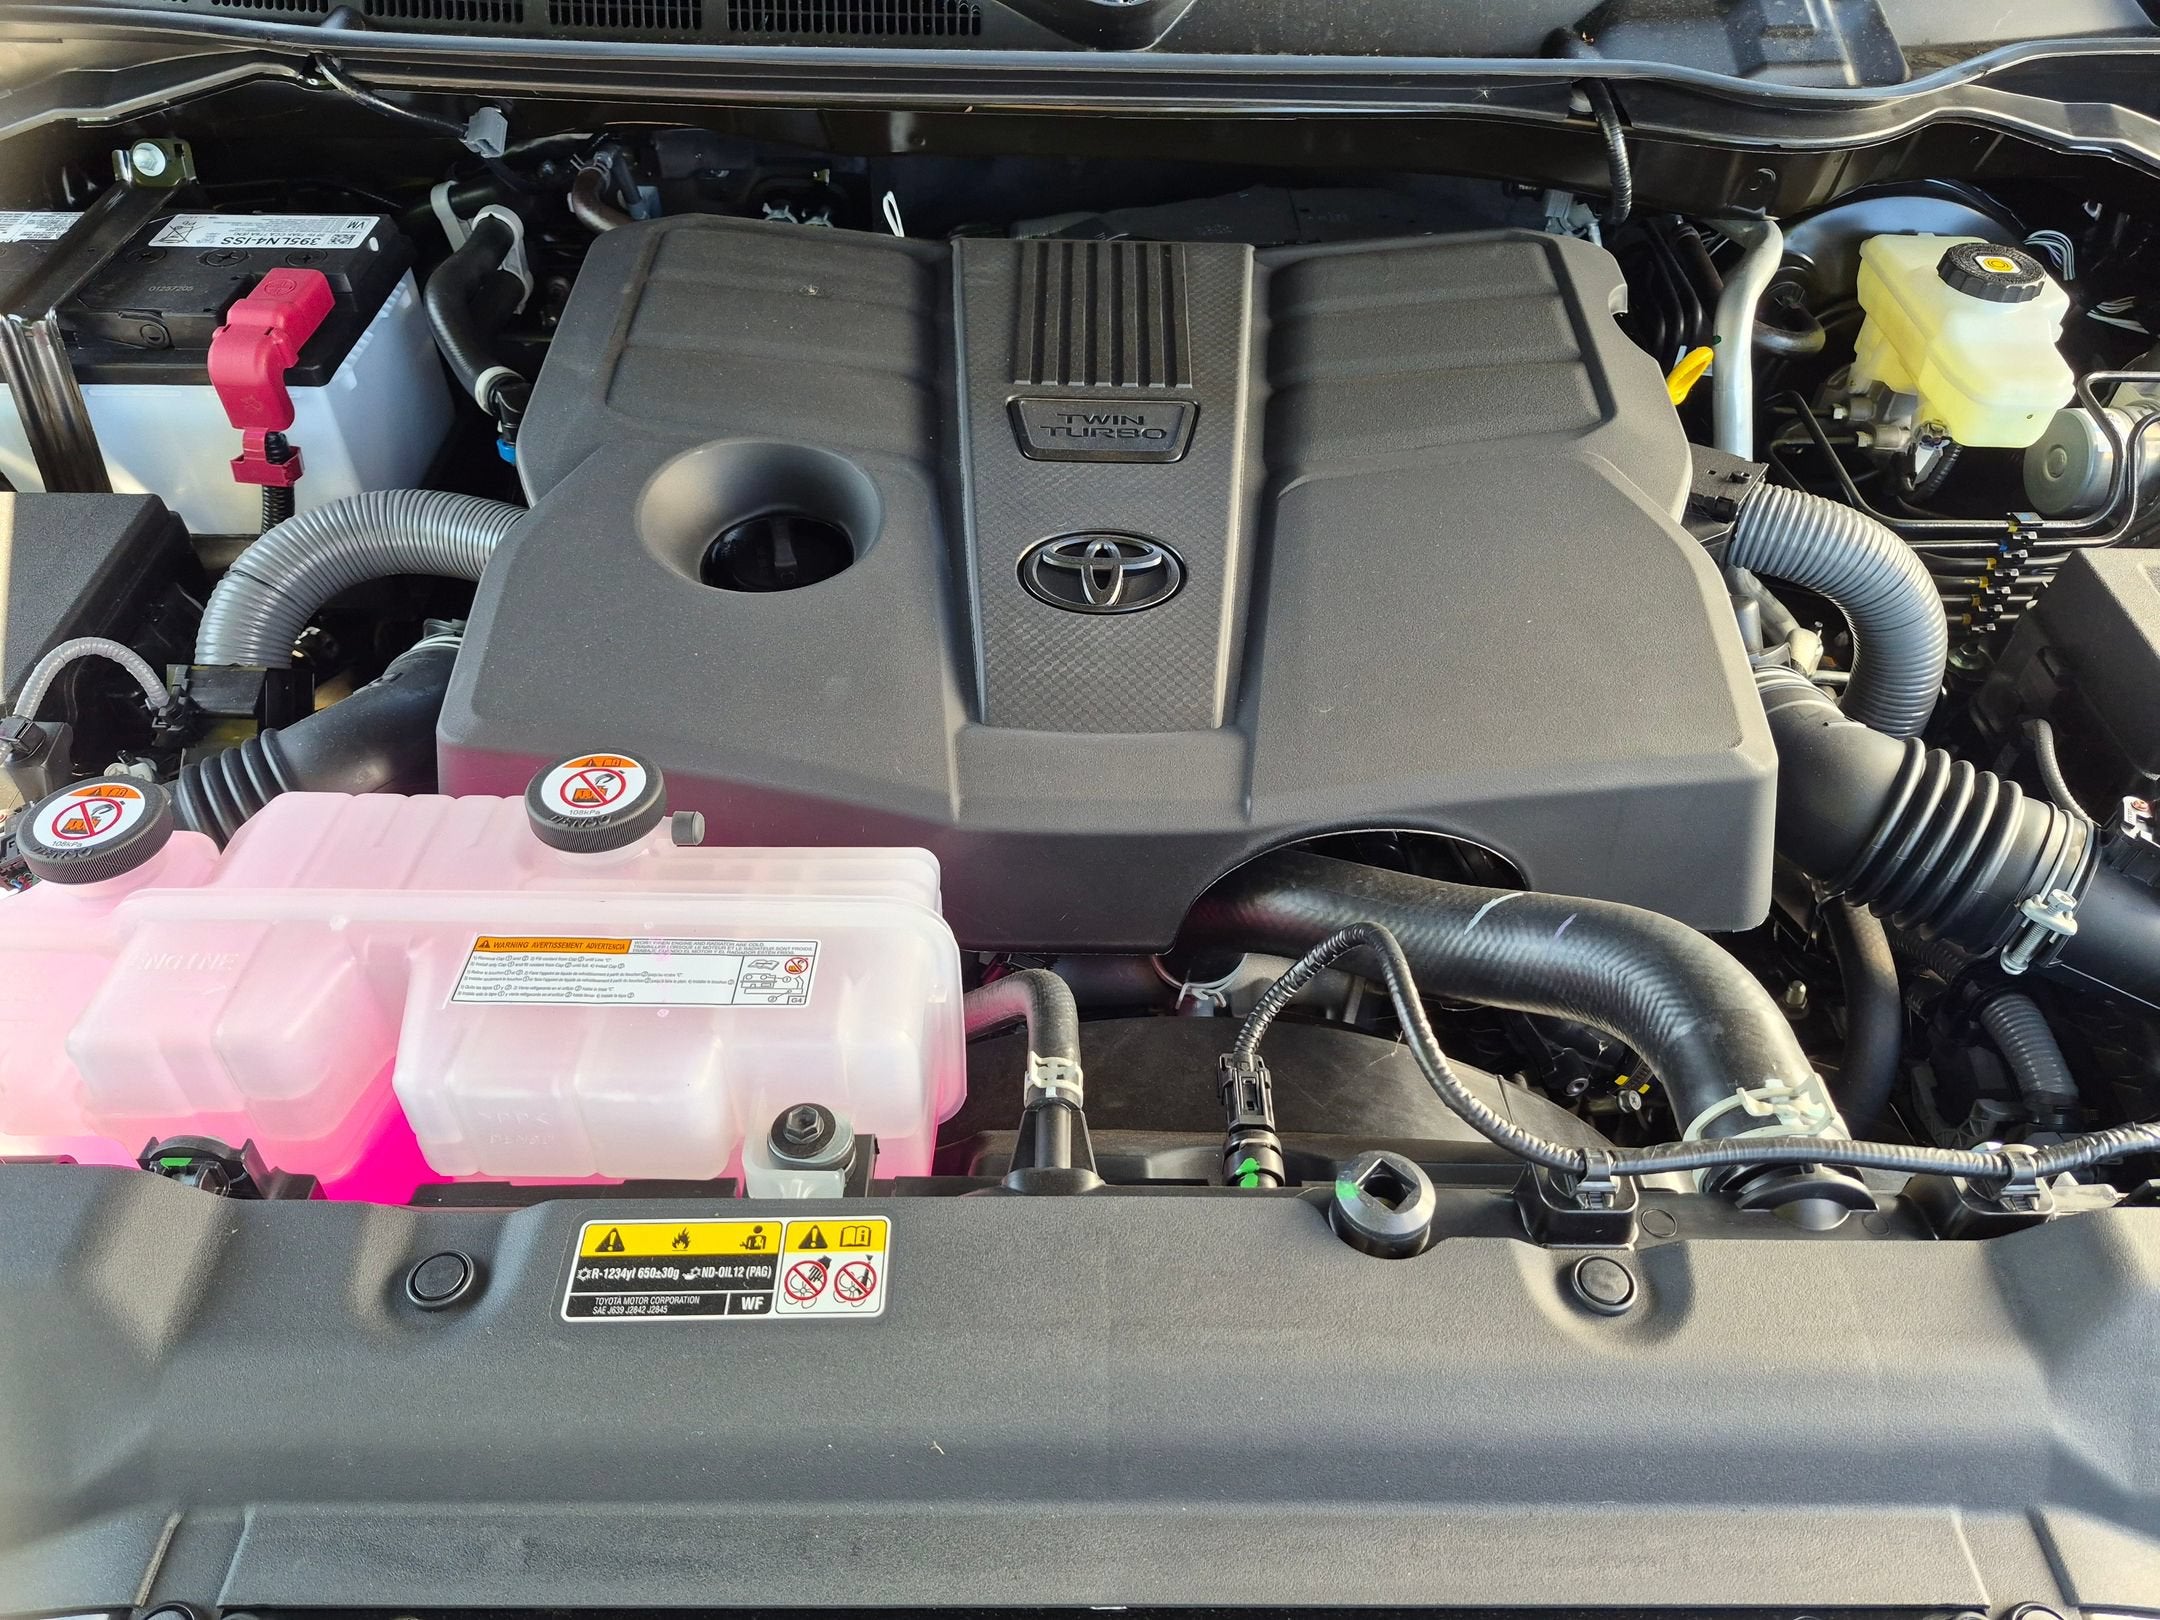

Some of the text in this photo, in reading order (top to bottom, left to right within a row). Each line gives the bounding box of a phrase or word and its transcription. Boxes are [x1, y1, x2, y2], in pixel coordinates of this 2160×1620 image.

[345, 220, 366, 230] VM
[221, 236, 322, 246] 395LN4-ISS
[1057, 413, 1144, 425] TWIN
[1039, 426, 1168, 440] TURBO
[493, 941, 530, 949] WARNING
[585, 942, 626, 950] ADVERTENCIA
[591, 1265, 772, 1281] R-1234yf 650±30g ND-OIL12 (PAG)
[594, 1295, 701, 1305] TOYOTA MOTOR CORPORATION
[741, 1296, 764, 1310] WF
[592, 1305, 668, 1315] SAE J639 J2842 J2845
